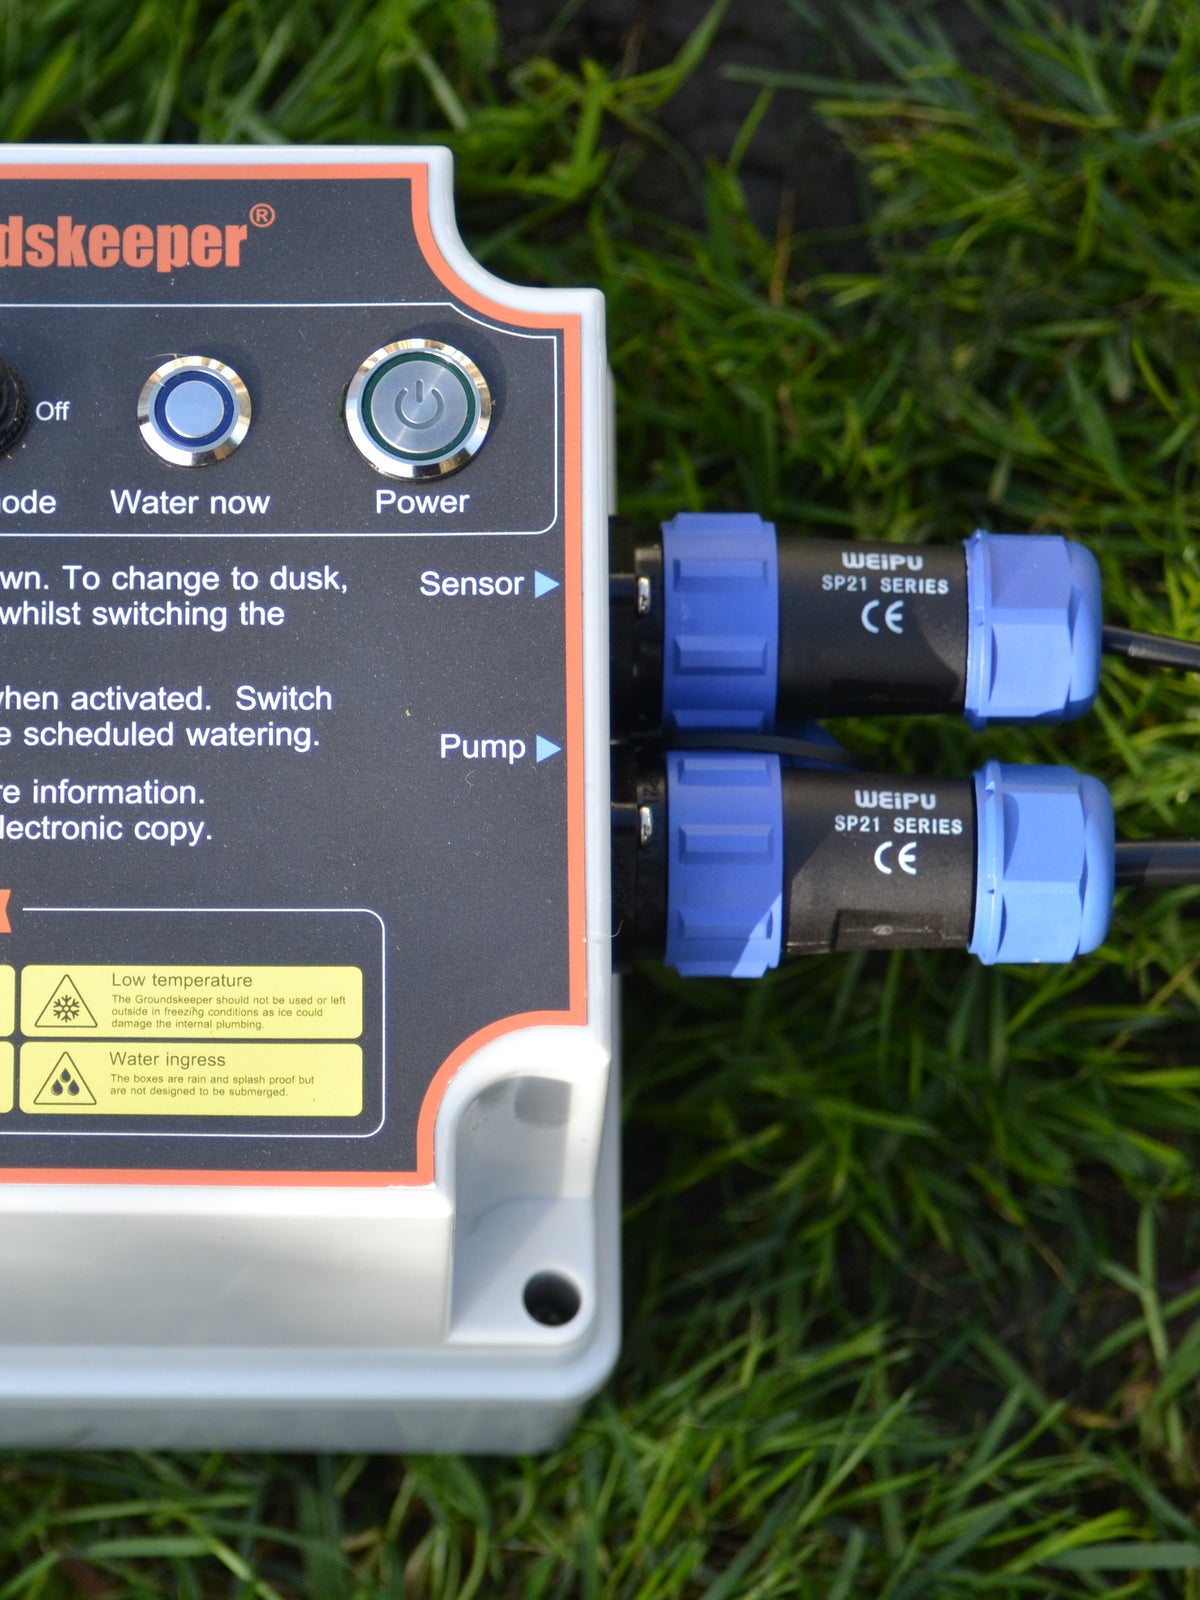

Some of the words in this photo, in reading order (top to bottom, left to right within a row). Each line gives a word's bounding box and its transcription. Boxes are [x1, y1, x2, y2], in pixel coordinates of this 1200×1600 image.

[36, 401, 70, 421] Off
[110, 489, 199, 514] Water
[211, 495, 270, 514] now
[376, 489, 470, 514] Power
[62, 565, 100, 590] To
[112, 565, 220, 597] change
[231, 566, 259, 590] to
[270, 565, 347, 594] dusk,
[420, 571, 525, 596] Sensor
[822, 575, 866, 591] SP21
[881, 577, 949, 594] SERIES
[92, 601, 227, 632] switching
[239, 600, 285, 626] the
[71, 685, 211, 711] activated.
[236, 685, 332, 711] Switch
[24, 721, 174, 746] scheduled
[186, 721, 319, 753] watering.
[441, 733, 526, 765] Pump
[33, 778, 204, 804] information.
[134, 821, 212, 847] copy.
[835, 815, 879, 832] SP21
[894, 817, 963, 834] SERIES
[112, 972, 146, 986] Low
[152, 973, 252, 990] temperature
[111, 1007, 148, 1016] outside
[152, 1007, 160, 1016] in
[164, 1006, 204, 1018] freezing
[208, 1007, 259, 1017] conditions
[262, 1009, 274, 1017] as
[278, 1008, 292, 1017] ice
[296, 1008, 323, 1017] could
[109, 1051, 159, 1066] Water
[166, 1055, 226, 1070] ingress
[130, 1087, 146, 1095] not
[149, 1086, 195, 1098] designed
[199, 1087, 209, 1096] to
[213, 1087, 225, 1096] be
